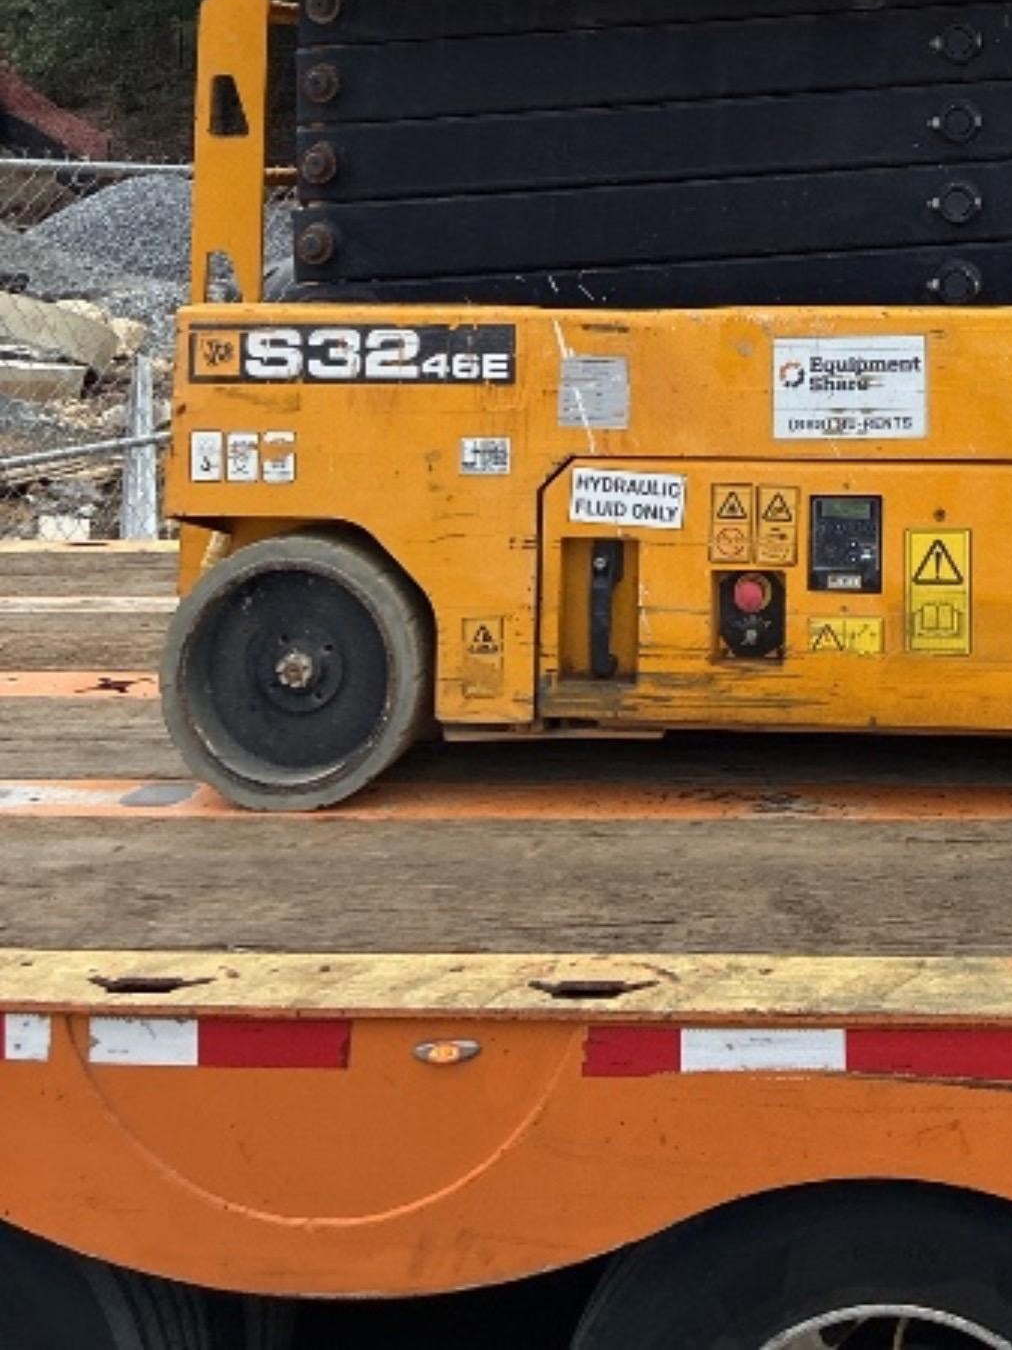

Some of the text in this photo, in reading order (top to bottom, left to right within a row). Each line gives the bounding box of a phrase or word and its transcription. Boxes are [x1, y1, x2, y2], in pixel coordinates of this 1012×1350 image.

[809, 356, 921, 375] Equipment
[577, 474, 681, 498] HYDRAULIC
[575, 498, 679, 522] FLUID ONLY
